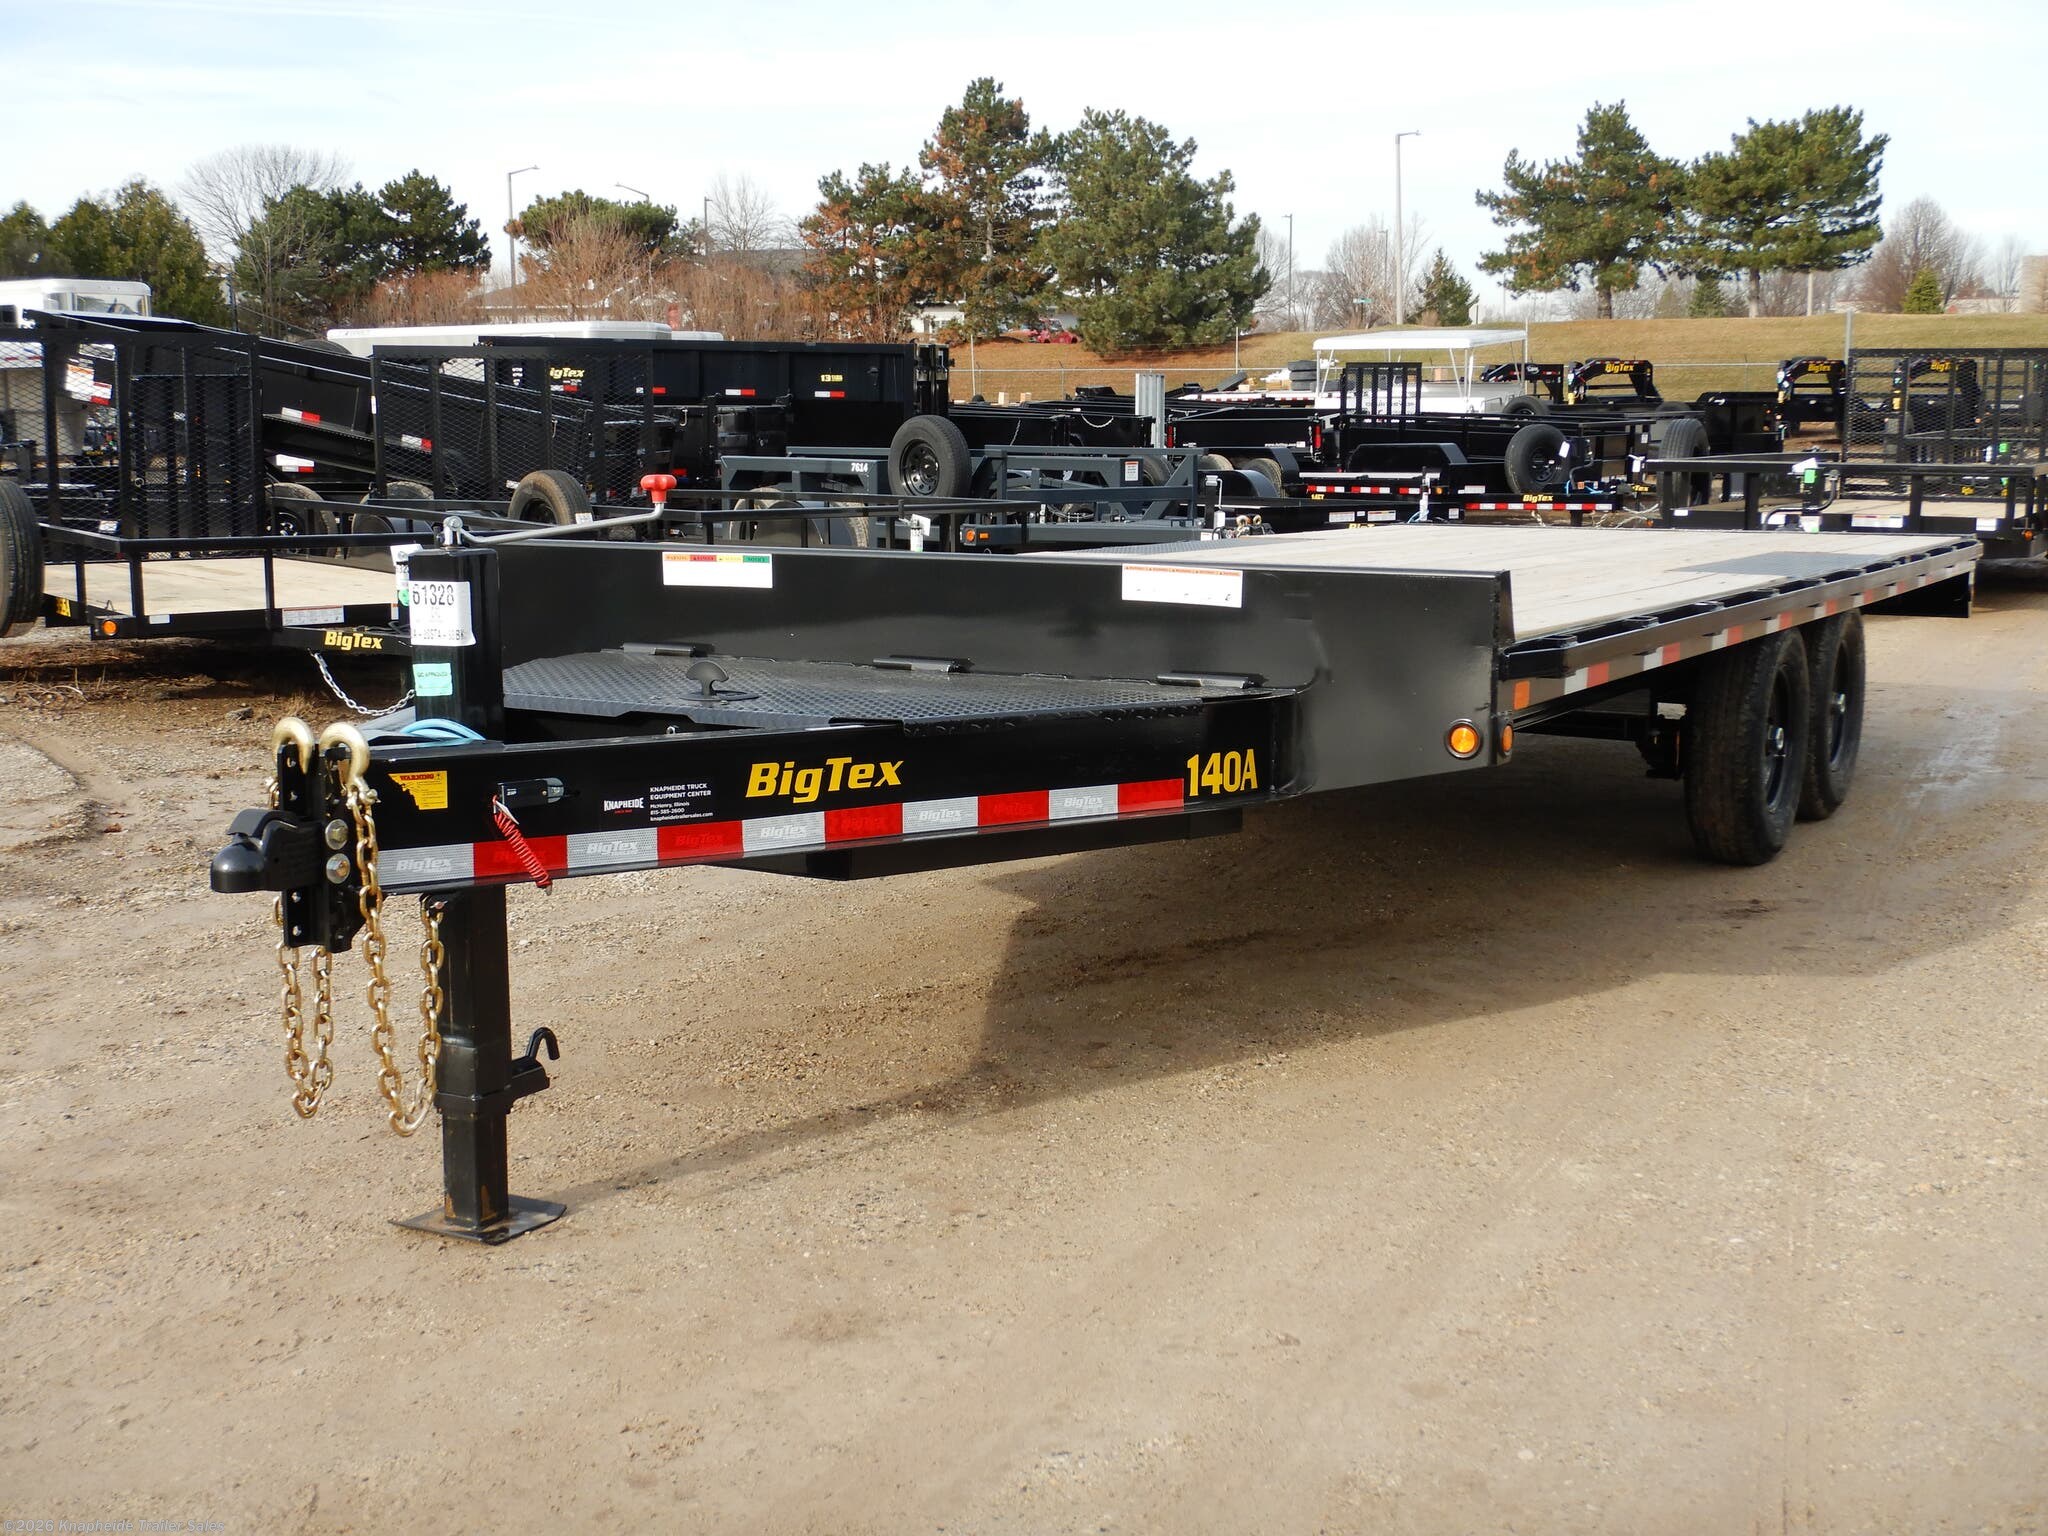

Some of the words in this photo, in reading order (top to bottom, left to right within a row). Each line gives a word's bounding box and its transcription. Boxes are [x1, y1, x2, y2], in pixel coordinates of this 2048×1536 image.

[549, 367, 585, 379] igTex
[1605, 363, 1635, 374] BigTex
[1522, 494, 1554, 504] BigTex
[412, 583, 455, 606] 61328
[324, 631, 383, 651] BigTex
[745, 756, 904, 804] BigTex
[1187, 748, 1259, 797] 140A
[650, 784, 686, 793] KNAPHEIDE
[686, 783, 708, 791] TRUCK
[650, 791, 686, 800] EQUIPMENT
[687, 789, 712, 797] CENTER
[603, 796, 645, 812] KNAPHEIDE
[1064, 795, 1104, 808] BigTex
[919, 808, 962, 822] BigTex
[760, 824, 808, 839] BigTex
[586, 840, 639, 855] BigTex
[395, 857, 453, 873] BigTex
